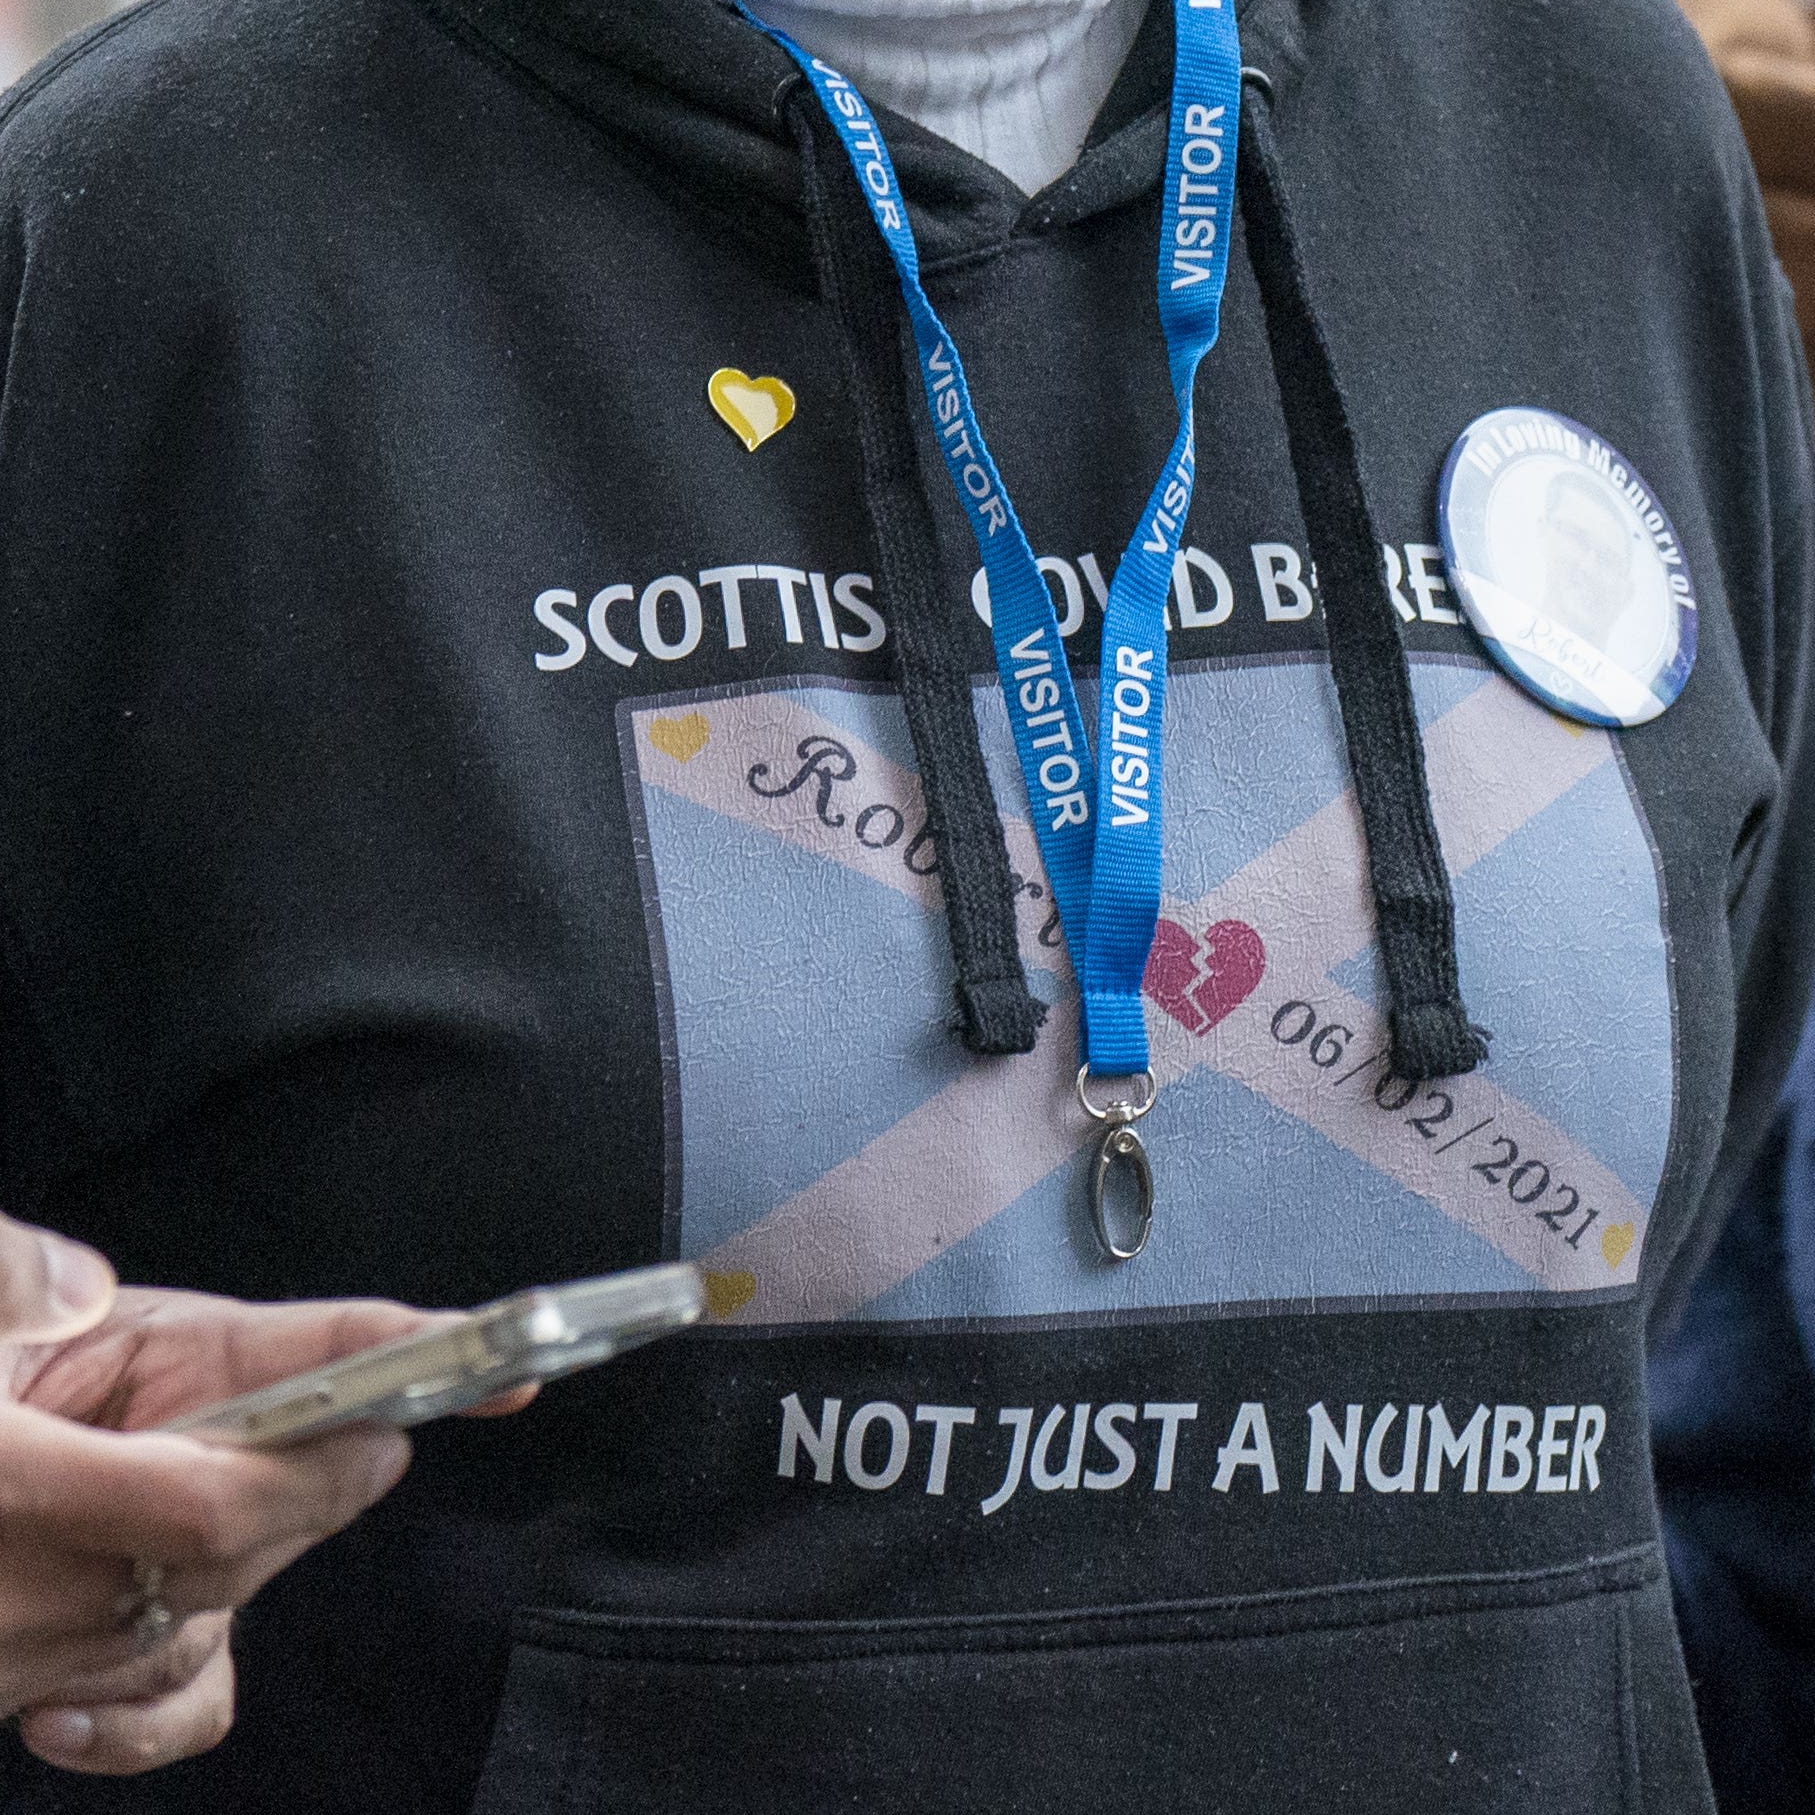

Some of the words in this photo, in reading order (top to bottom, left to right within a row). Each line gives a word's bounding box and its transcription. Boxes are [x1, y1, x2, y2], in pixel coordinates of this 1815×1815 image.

[811, 58, 901, 231] VISITOR
[1170, 103, 1225, 291] VISITOR
[928, 340, 1008, 538] VISITOR
[1142, 406, 1196, 554] VISIT
[1465, 441, 1503, 479] In
[1489, 418, 1581, 460] Loving
[1587, 438, 1682, 565] Memory
[1669, 573, 1697, 611] of
[533, 564, 888, 672] SCOTTIS
[1009, 627, 1089, 832] VISITOR
[1110, 645, 1154, 828] VISITOR
[1269, 999, 1599, 1251] 06/02/2021
[778, 1392, 975, 1496] NOT
[981, 1402, 1198, 1515] JUST
[1212, 1402, 1280, 1494] A
[1306, 1400, 1607, 1494] NUMBER
